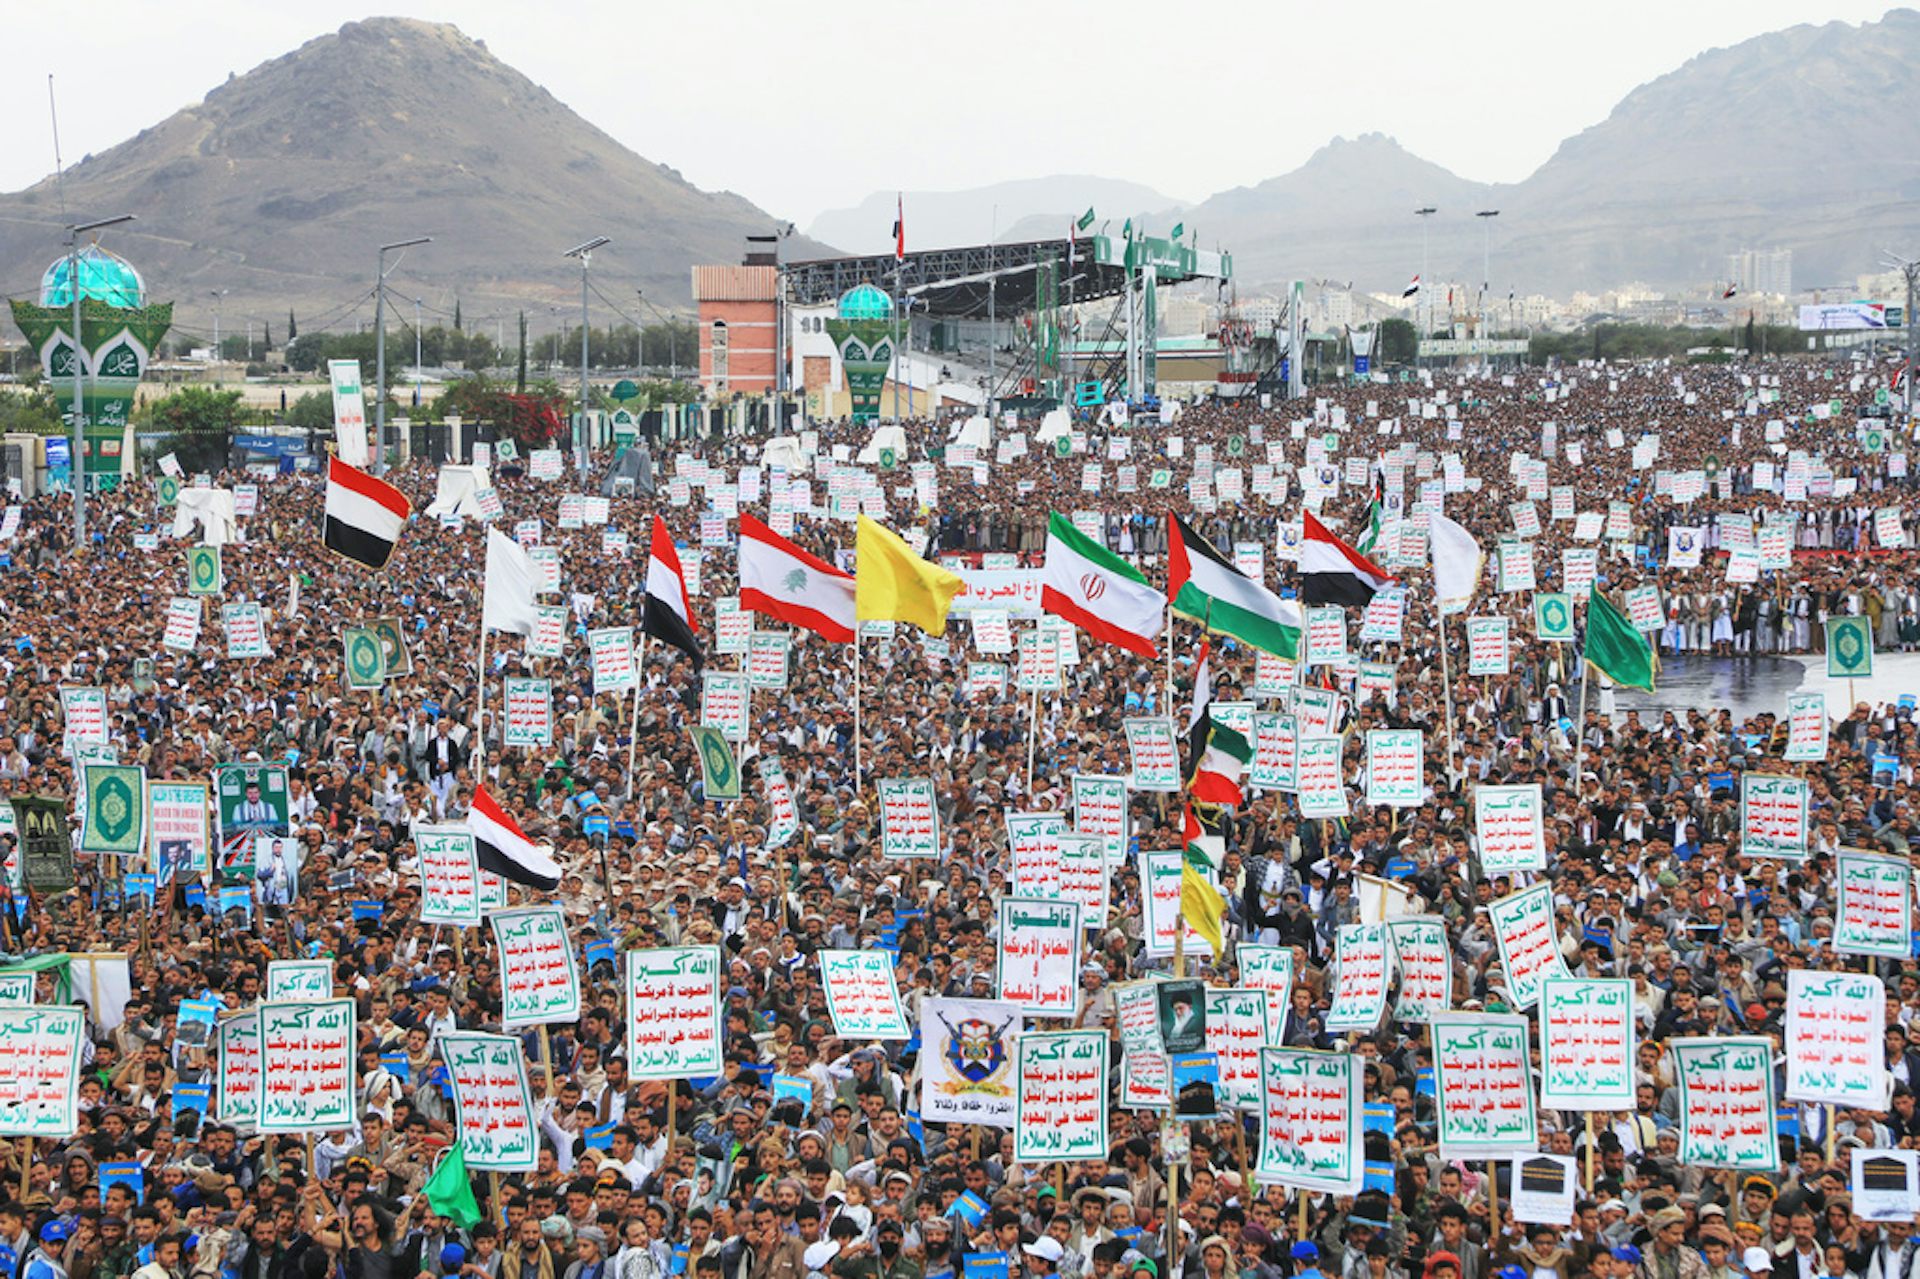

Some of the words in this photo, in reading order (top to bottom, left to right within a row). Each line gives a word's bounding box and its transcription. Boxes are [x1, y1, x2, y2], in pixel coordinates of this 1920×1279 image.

[975, 582, 1021, 600] الحرب
[536, 918, 557, 933] الله
[1008, 905, 1071, 931] قاطعوا
[502, 918, 533, 939] أكبر
[535, 942, 562, 952] الموت
[1041, 938, 1073, 960] البضائع
[636, 953, 692, 981] أكبر
[690, 957, 712, 974] الله
[1032, 960, 1039, 978] و
[275, 972, 303, 994] أكبر
[306, 973, 327, 990] الله
[678, 983, 711, 997] الموت
[542, 991, 570, 1009] النصر
[1550, 986, 1594, 1010] أكبر
[1597, 989, 1624, 1005] الله
[46, 1019, 76, 1035] الله
[269, 1008, 314, 1035] أكبر
[317, 1009, 346, 1029] الله
[1592, 1014, 1623, 1026] الموت
[311, 1037, 345, 1050] الموت
[1071, 1040, 1100, 1059] الله
[1442, 1028, 1489, 1053] أكبر
[1491, 1031, 1519, 1049] الله
[452, 1045, 488, 1071] أكبر
[489, 1045, 514, 1066] الله
[683, 1048, 714, 1067] النصر
[1025, 1038, 1068, 1064] أكبر
[1268, 1055, 1309, 1081] أكبر
[1315, 1059, 1346, 1078] الله
[1487, 1058, 1522, 1071] الموت
[1685, 1050, 1728, 1076] أكبر
[1731, 1053, 1763, 1072] الله
[489, 1074, 518, 1088] الموت
[1066, 1068, 1098, 1083] الموت
[1593, 1072, 1624, 1090] النصر
[1310, 1086, 1346, 1101] الموت
[1728, 1080, 1764, 1094] الموت
[310, 1097, 346, 1120] النصر
[1492, 1116, 1528, 1136] النصر
[494, 1133, 530, 1158] النصر
[1064, 1128, 1098, 1152] النصر
[1735, 1141, 1769, 1162] النصر
[1311, 1149, 1344, 1174] النصر
